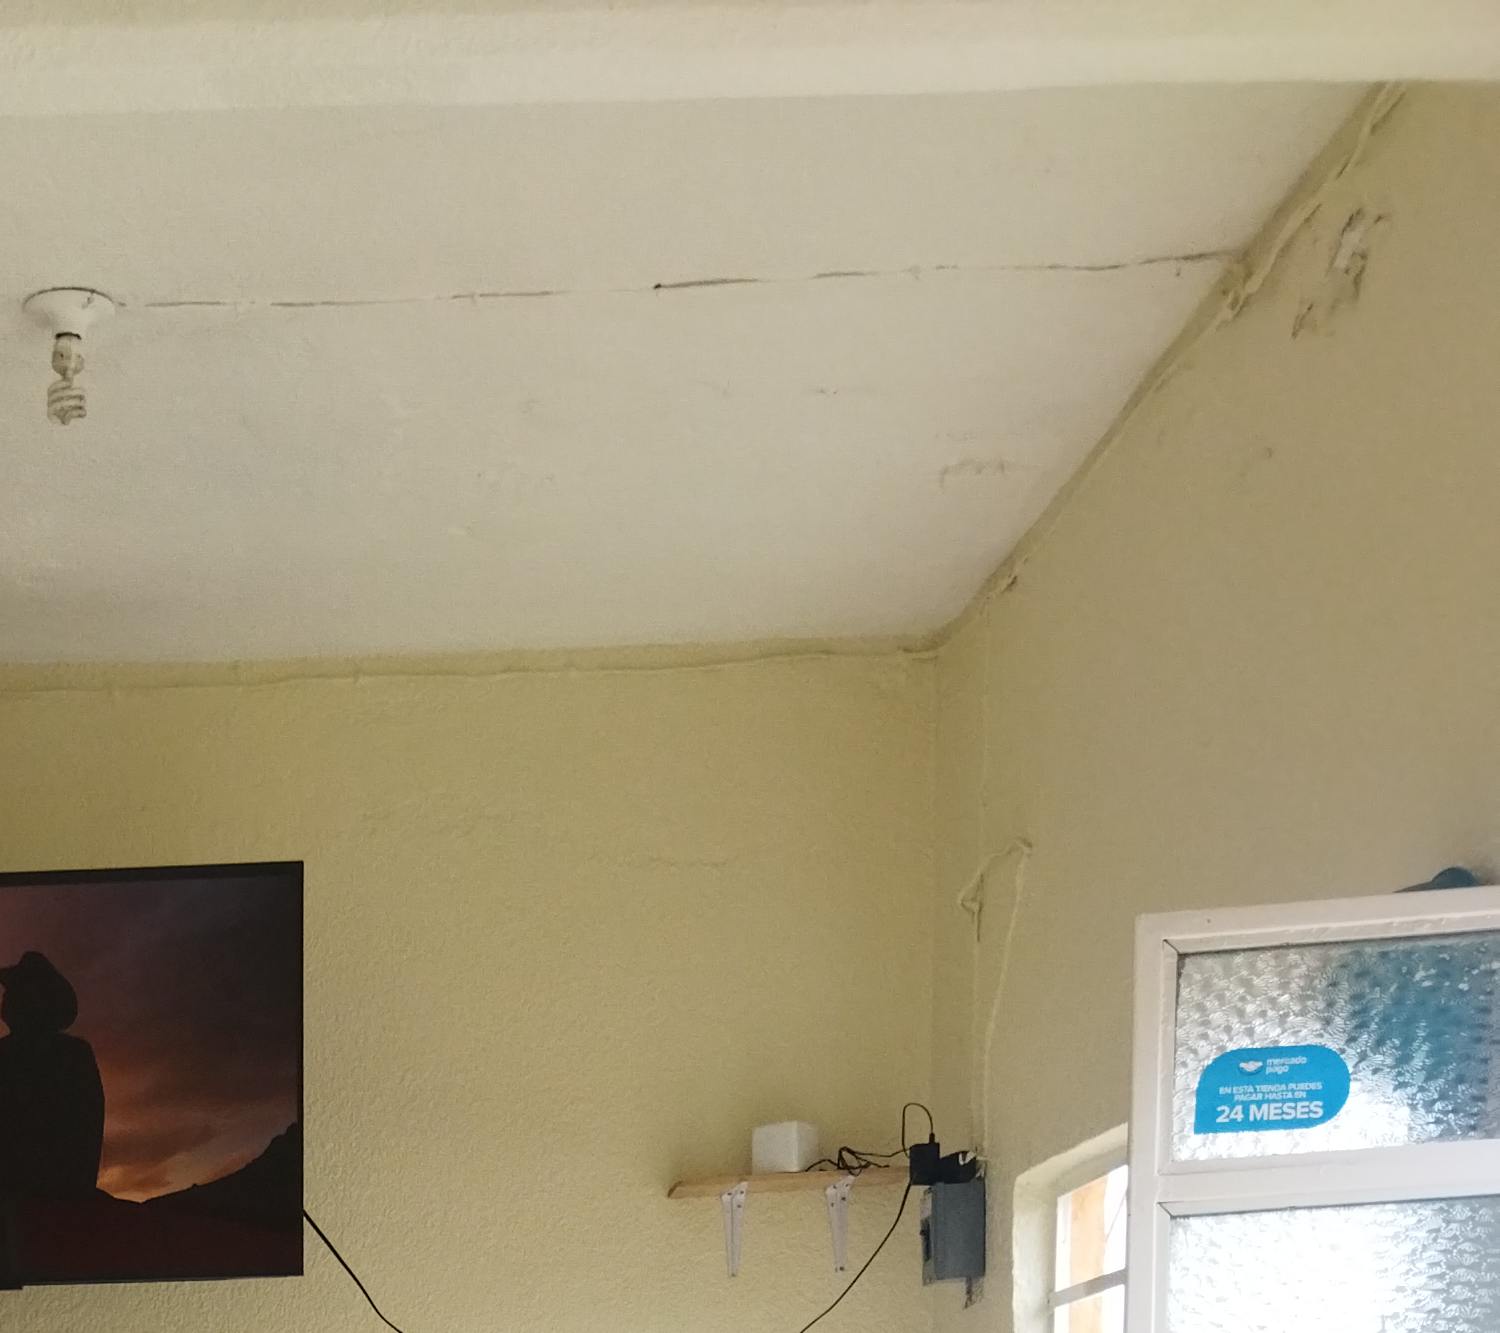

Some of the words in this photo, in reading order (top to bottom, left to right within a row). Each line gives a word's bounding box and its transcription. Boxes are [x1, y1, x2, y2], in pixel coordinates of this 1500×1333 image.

[1266, 1056, 1307, 1066] mercado
[1265, 1065, 1289, 1075] pago
[1232, 1085, 1254, 1094] ESTA
[1264, 1091, 1293, 1101] HASTA
[1216, 1105, 1244, 1123] 24
[1249, 1101, 1324, 1121] MESES
